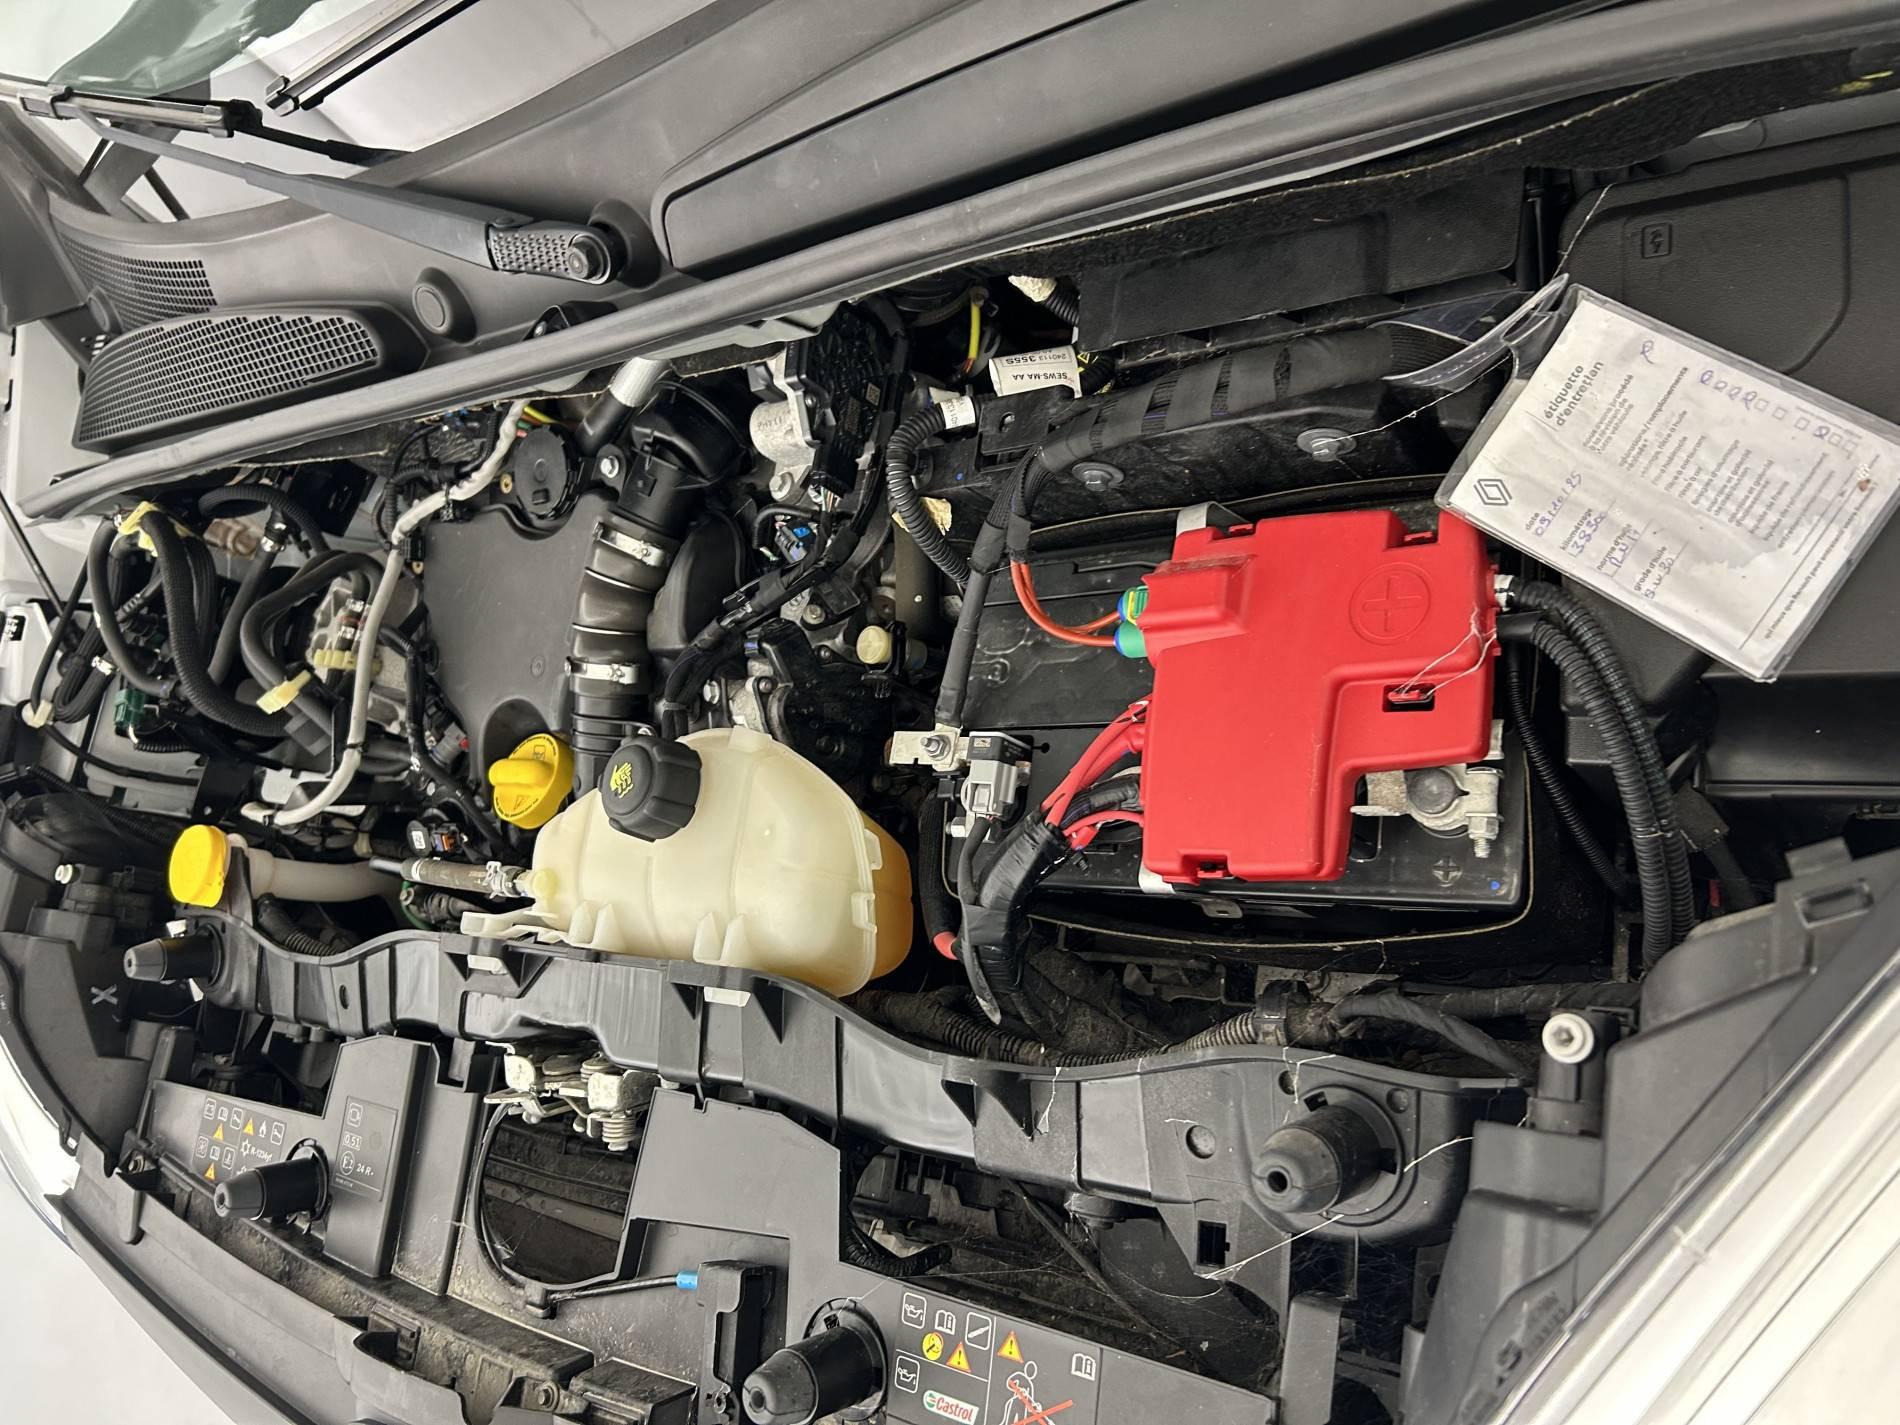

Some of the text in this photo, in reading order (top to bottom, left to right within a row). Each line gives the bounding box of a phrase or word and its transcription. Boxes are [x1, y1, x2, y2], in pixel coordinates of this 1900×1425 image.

[1027, 372, 1068, 380] SEWS-MA
[1525, 512, 1539, 530] date
[1559, 508, 1592, 551] kilométrage
[1596, 546, 1616, 570] norme
[1633, 568, 1651, 591] grade
[936, 1398, 973, 1422] Castrol
